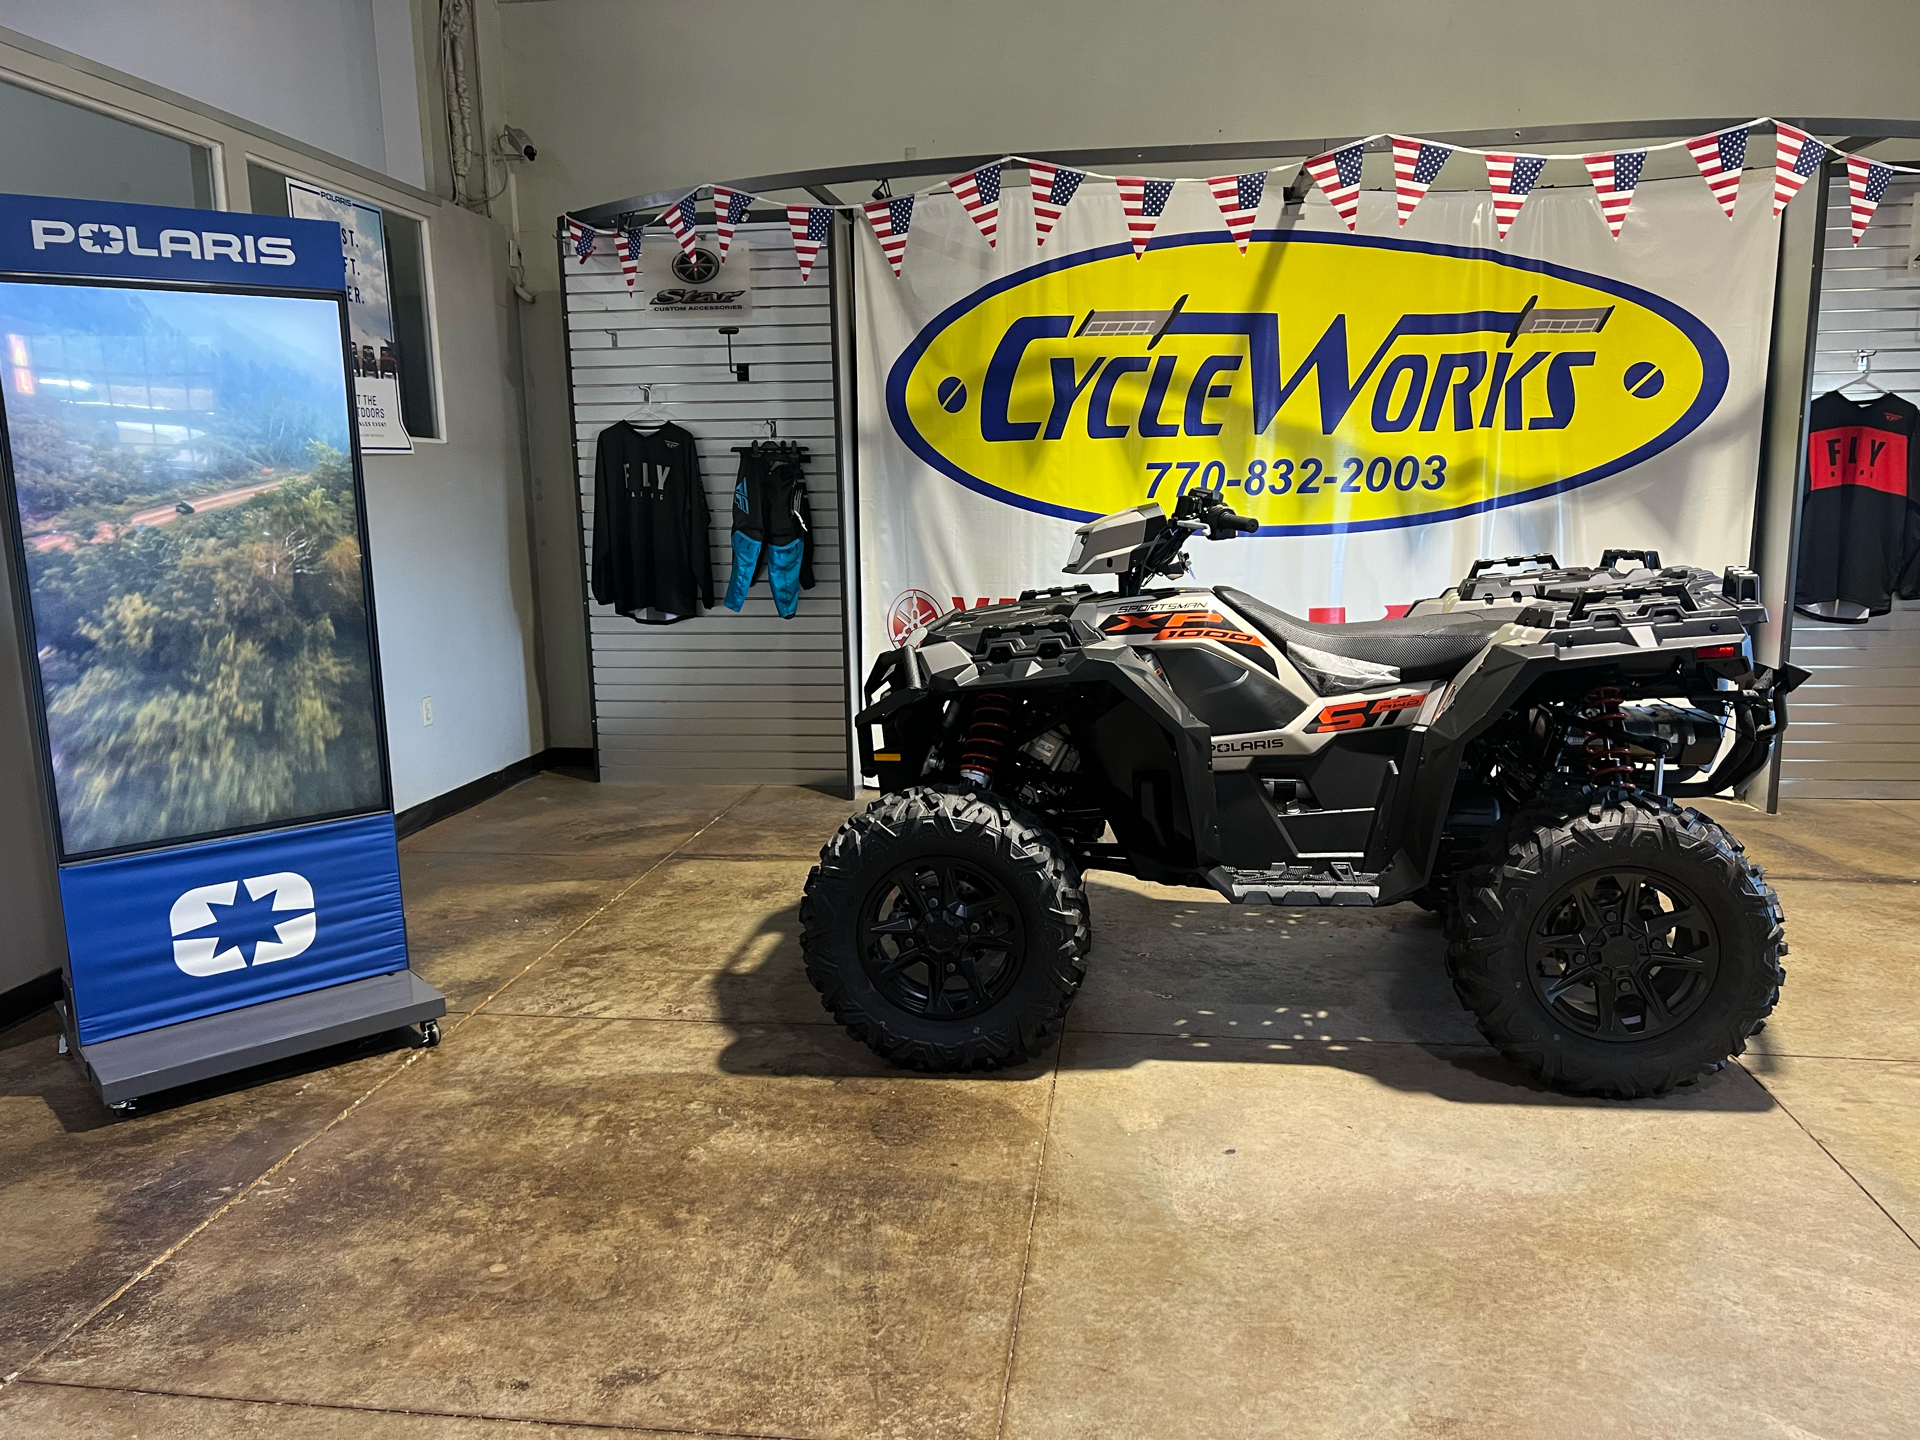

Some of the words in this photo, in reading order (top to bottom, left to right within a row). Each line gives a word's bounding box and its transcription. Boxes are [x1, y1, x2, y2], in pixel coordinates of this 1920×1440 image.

[319, 190, 352, 207] POLARIS
[30, 219, 297, 266] POLARIS
[363, 394, 378, 406] THE
[1145, 454, 1448, 498] 770-832-2003
[1117, 602, 1208, 614] SPORTSMAN
[1104, 612, 1224, 632] XP
[1166, 629, 1254, 642] 1000
